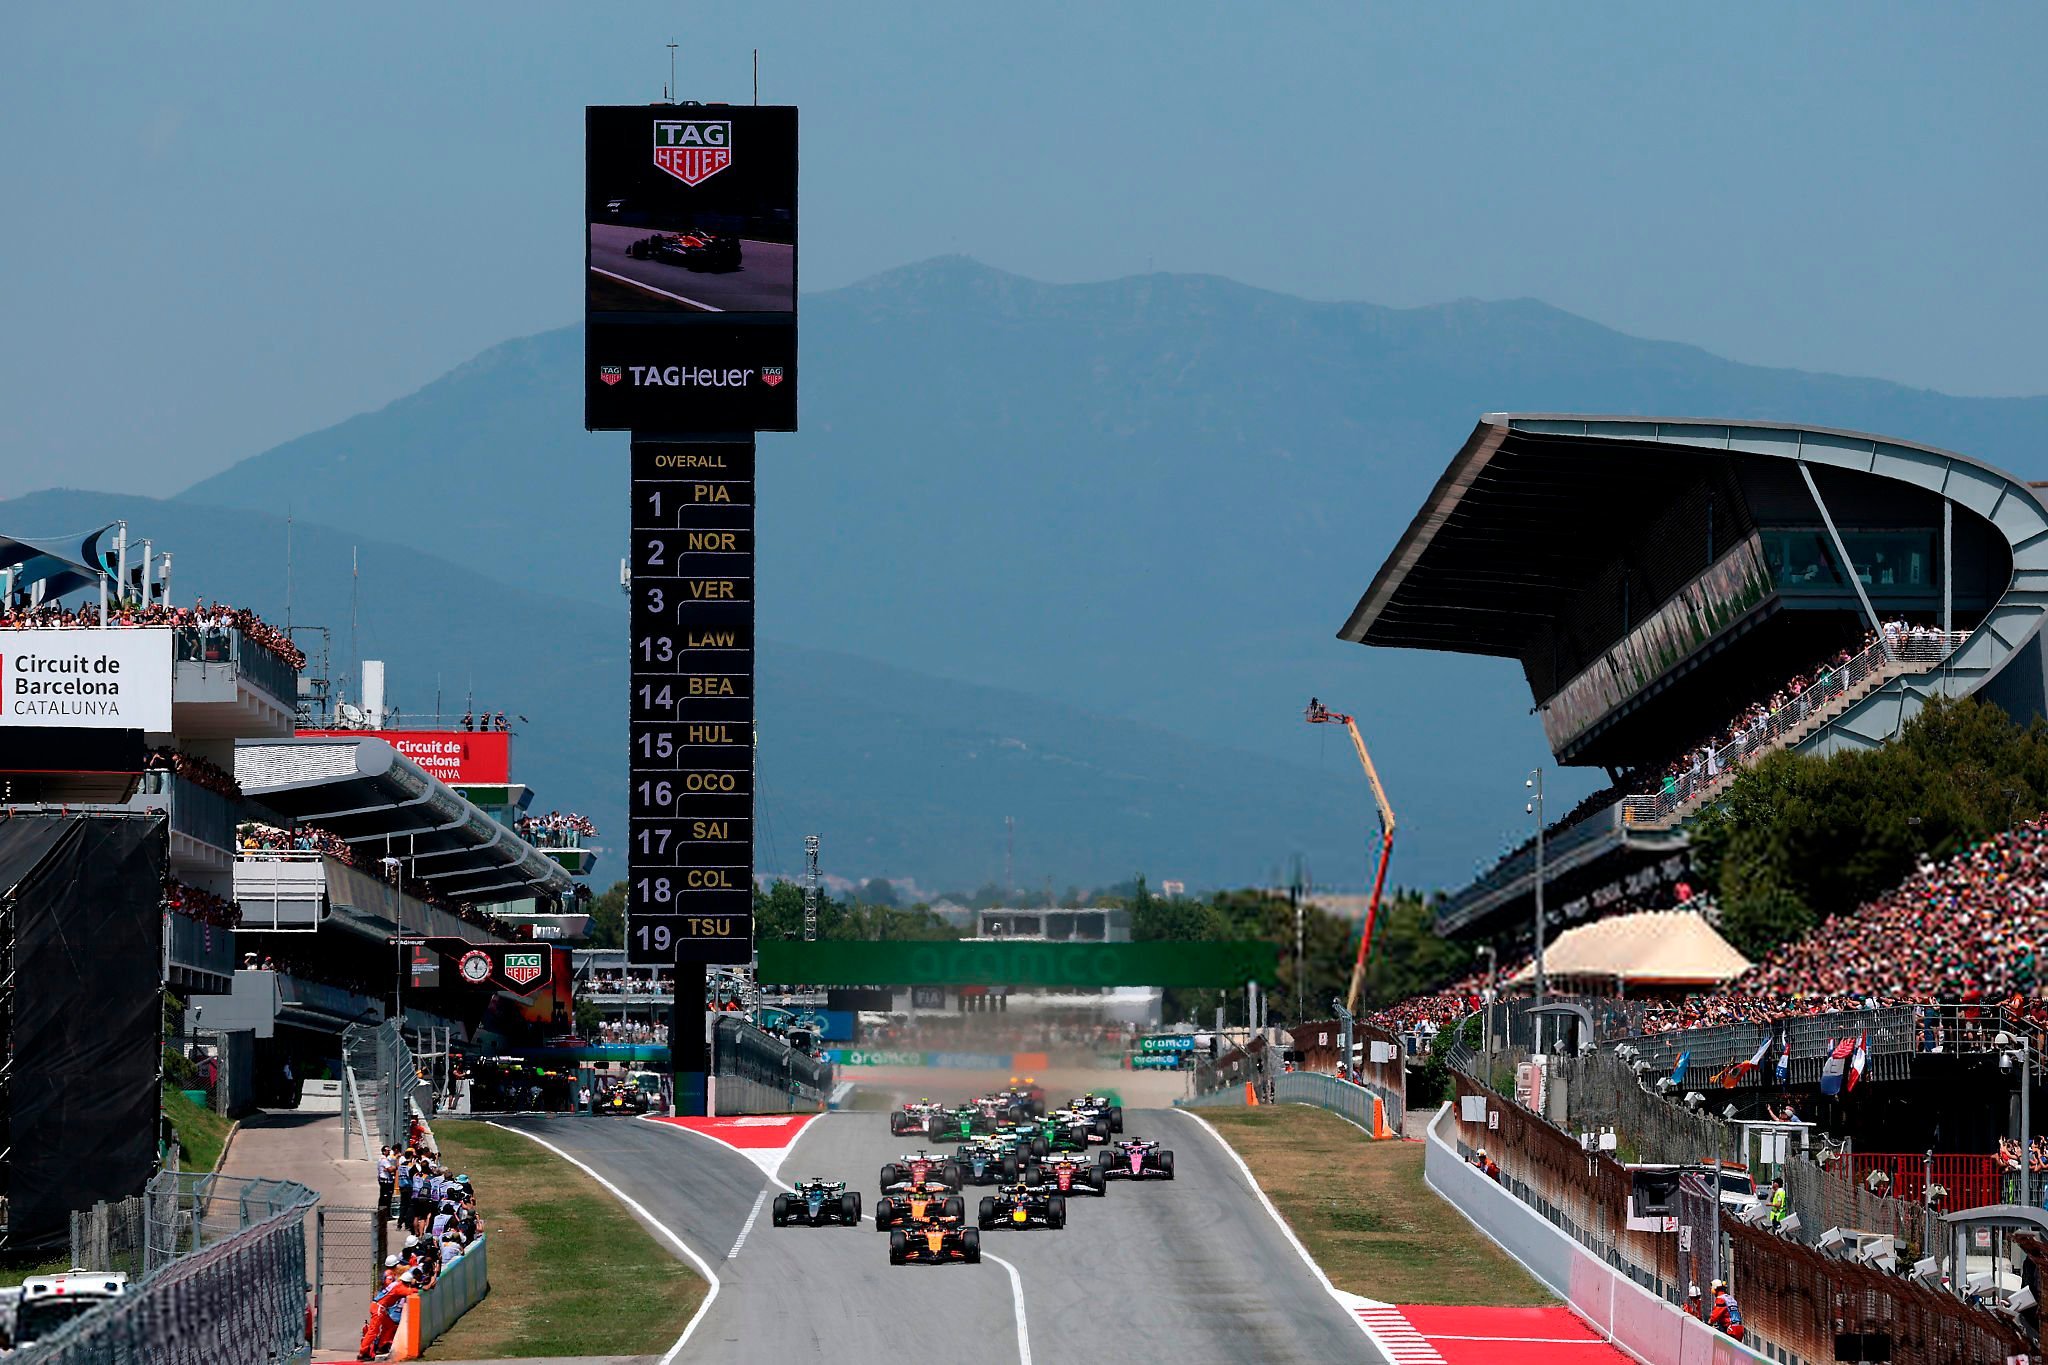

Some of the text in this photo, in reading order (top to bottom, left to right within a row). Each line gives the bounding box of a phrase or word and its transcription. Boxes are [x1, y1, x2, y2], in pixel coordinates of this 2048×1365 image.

[660, 124, 724, 145] TAG
[658, 150, 727, 181] HEUER
[655, 455, 727, 468] OVERALL
[649, 484, 731, 517] 1 PIA
[647, 533, 736, 565] 2 NOR
[647, 581, 734, 613] 3 VER
[639, 633, 735, 662] 13 LAW
[15, 654, 120, 674] Circuit de
[15, 677, 119, 695] Barcelona
[639, 678, 734, 710] 14 BEA
[14, 700, 120, 715] CATALUNYA
[396, 740, 461, 753] Circuit de
[638, 726, 733, 758] 15 HUL
[638, 774, 735, 806] 16 OCO
[638, 822, 728, 854] 17 SAI
[637, 870, 732, 903] 18 COL
[636, 919, 730, 951] 19 TSU
[507, 968, 539, 982] HEUER
[508, 956, 538, 966] TAG
[911, 946, 1121, 981] aramco
[850, 1052, 920, 1064] aramco
[1143, 1039, 1191, 1048] aramco
